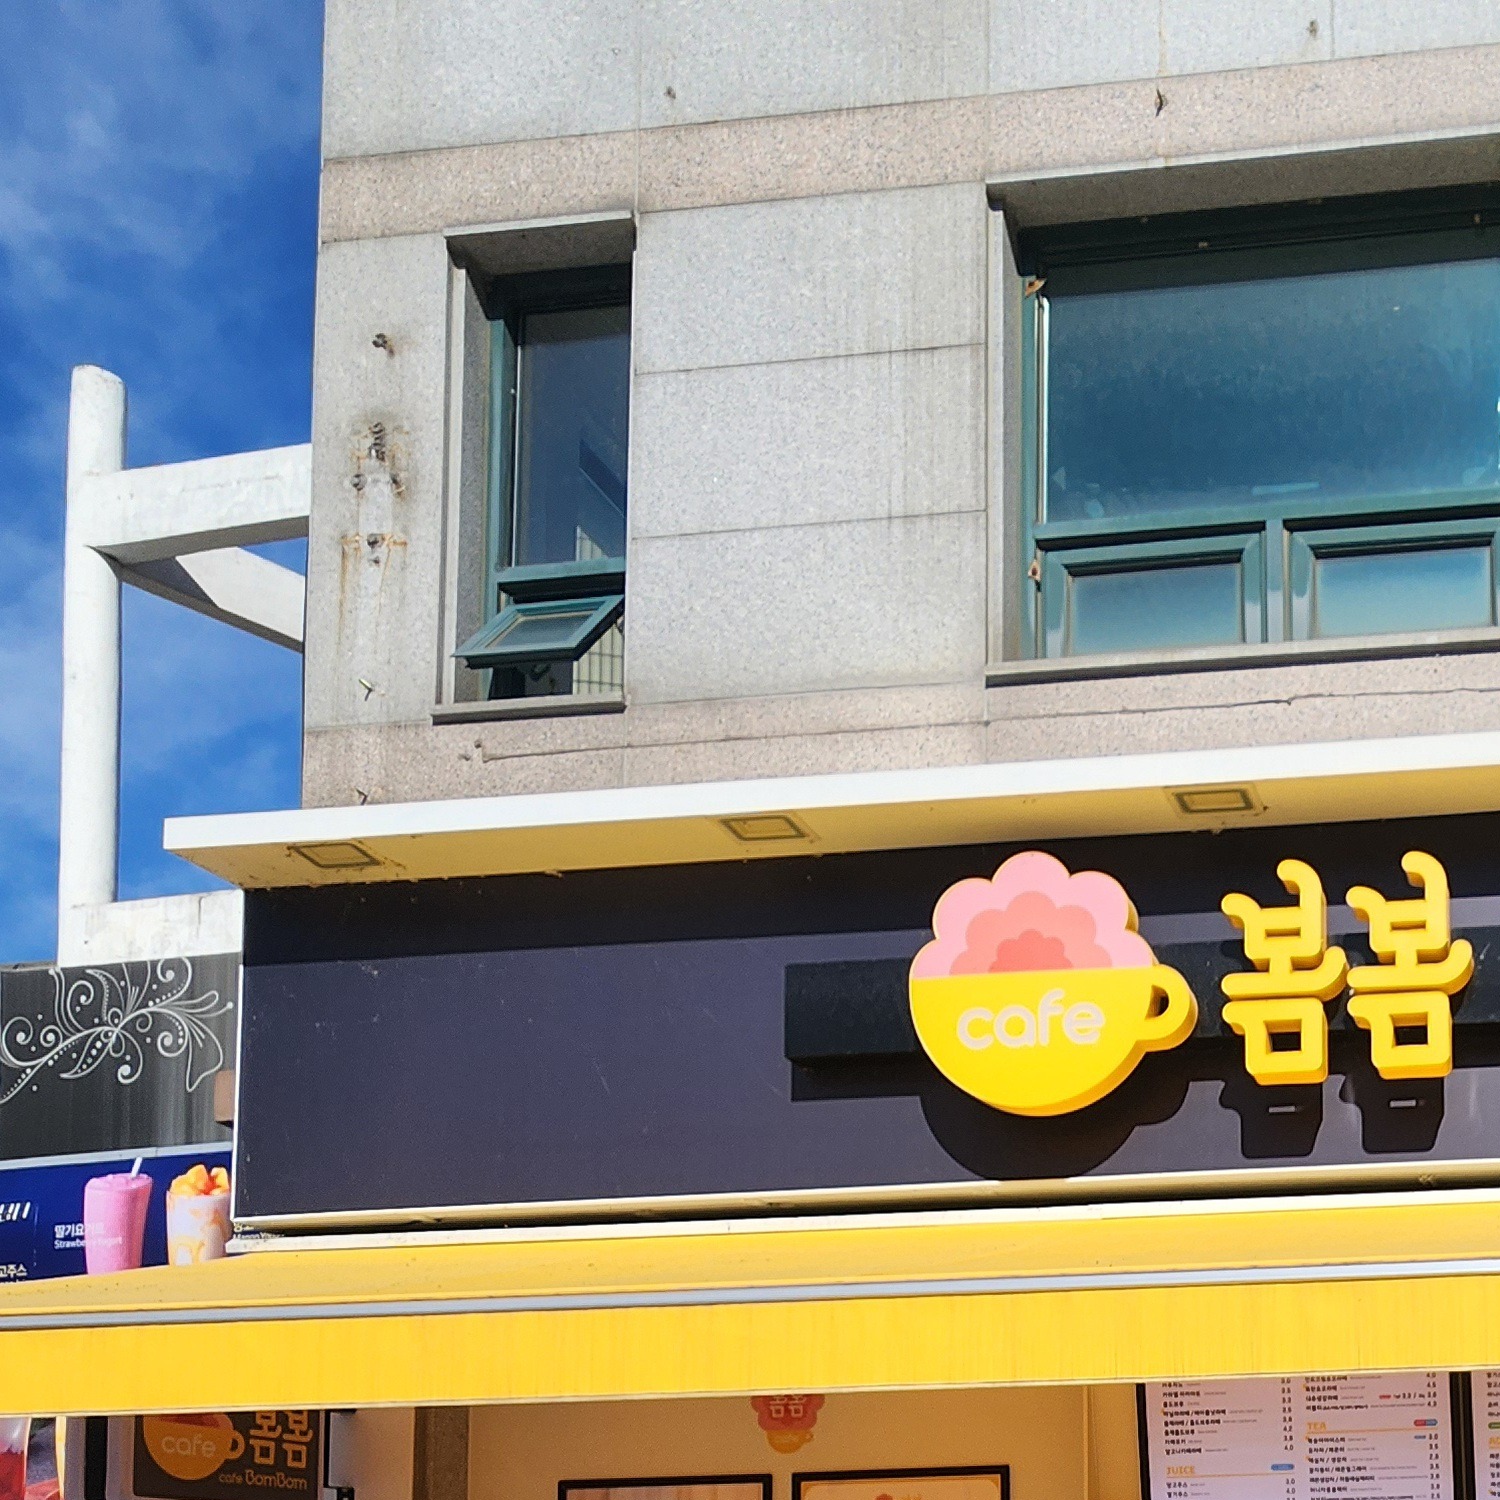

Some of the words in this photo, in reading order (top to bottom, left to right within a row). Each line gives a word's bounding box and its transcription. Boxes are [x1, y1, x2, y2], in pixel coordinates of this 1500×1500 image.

[1220, 850, 1474, 1085] 봄봄
[955, 991, 1105, 1051] cafe
[160, 1433, 217, 1458] cafe
[244, 1469, 308, 1490] BomBom
